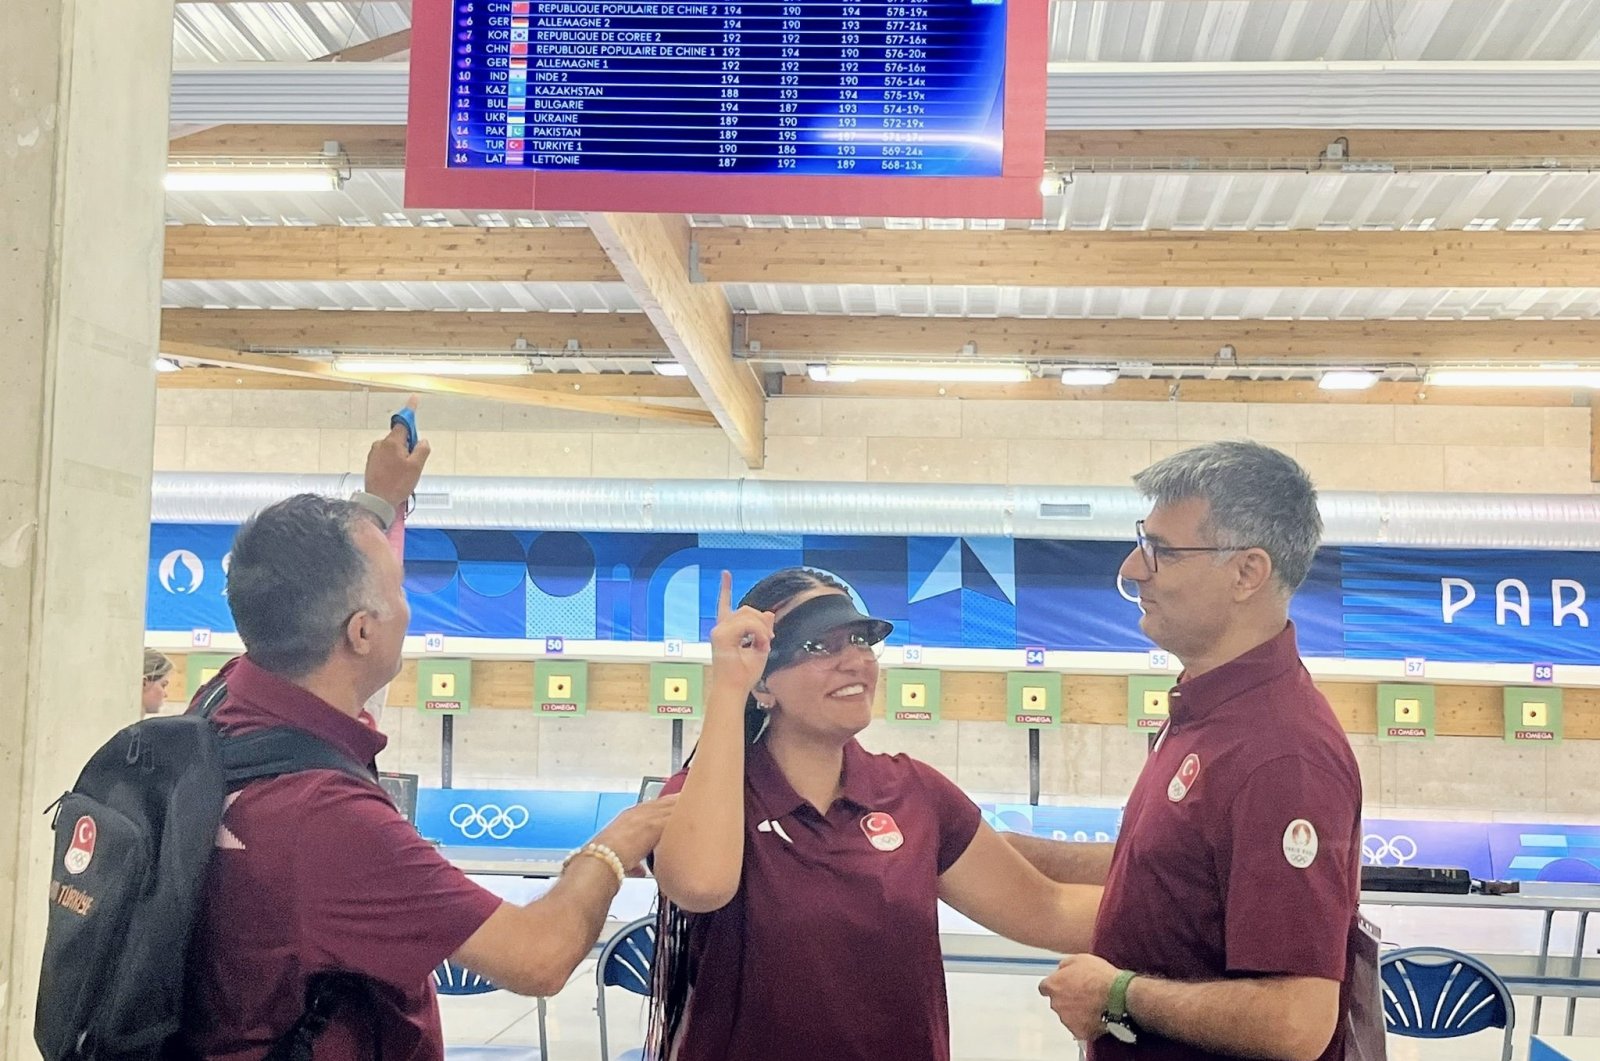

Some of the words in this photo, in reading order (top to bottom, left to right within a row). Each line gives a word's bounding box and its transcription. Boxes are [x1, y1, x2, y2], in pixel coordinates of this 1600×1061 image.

[468, 4, 473, 12] 5
[488, 4, 510, 12] CHN
[538, 4, 600, 14] REPUBLIQUE
[602, 5, 659, 13] POPULAIRE
[661, 5, 674, 14] DE
[676, 5, 708, 14] CHINE
[711, 5, 717, 14] 2
[724, 7, 742, 16] 194
[783, 7, 800, 16] 190
[842, 7, 860, 16] 194
[887, 8, 928, 17] 578-19x
[467, 17, 472, 25] 6
[488, 17, 509, 26] GER
[538, 18, 602, 27] ALLEMAGNE
[603, 19, 610, 27] 2
[724, 20, 741, 30] 194
[782, 21, 800, 30] 190
[842, 21, 860, 30] 193
[887, 22, 927, 30] 577-21x
[488, 31, 508, 39] KOR
[537, 32, 599, 41] REPUBLIQUE
[602, 32, 615, 41] DE
[617, 33, 652, 42] COREE
[654, 33, 661, 42] 2
[723, 34, 740, 43] 192
[782, 34, 800, 43] 192
[841, 35, 859, 44] 193
[886, 35, 927, 44] 577-16x
[466, 44, 471, 53] 8
[486, 44, 508, 53] CHN
[537, 46, 599, 55] REPUBLIQUE
[601, 46, 658, 55] POPULAIRE
[660, 47, 672, 56] DE
[675, 47, 708, 56] CHINE
[710, 47, 715, 56] 1
[723, 48, 740, 57] 192
[782, 48, 799, 57] 194
[841, 48, 859, 57] 190
[886, 49, 926, 58] 576-20x
[465, 58, 471, 66] 9
[487, 58, 508, 67] GER
[536, 59, 600, 68] ALLEMAGNE
[602, 60, 608, 68] 1
[722, 62, 739, 70] 192
[781, 62, 798, 71] 192
[840, 62, 858, 71] 192
[885, 62, 926, 72] 576-16x
[459, 72, 470, 80] 10
[490, 72, 507, 80] IND
[536, 73, 559, 81] INDE
[561, 73, 567, 82] 2
[722, 76, 739, 84] 194
[780, 76, 798, 85] 192
[840, 76, 858, 85] 190
[885, 76, 925, 86] 576-14x
[458, 86, 470, 94] 11
[486, 85, 507, 94] KAZ
[535, 86, 603, 95] KAZAKHSTAN
[721, 90, 738, 98] 188
[780, 90, 798, 99] 193
[839, 90, 857, 99] 194
[884, 90, 925, 100] 575-19x
[458, 99, 469, 107] 12
[487, 99, 506, 108] BUL
[534, 100, 583, 109] BULGARIE
[721, 103, 738, 112] 194
[780, 104, 797, 112] 187
[839, 104, 857, 113] 193
[884, 104, 924, 113] 574-19x
[457, 113, 469, 121] 13
[486, 113, 505, 121] UKR
[534, 114, 578, 123] UKRAINE
[720, 117, 737, 126] 189
[779, 117, 796, 126] 190
[838, 118, 856, 127] 193
[883, 118, 924, 127] 572-19x
[456, 127, 468, 135] 14
[486, 127, 504, 135] PAK
[534, 128, 580, 137] PAKISTAN
[720, 131, 737, 140] 189
[778, 131, 796, 140] 195
[456, 140, 467, 149] 15
[486, 140, 504, 149] TUR
[533, 141, 574, 150] TURKIYE
[576, 142, 582, 150] 1
[719, 145, 736, 154] 190
[778, 145, 796, 154] 186
[838, 145, 855, 154] 193
[882, 146, 922, 155] 569-24x
[455, 154, 467, 162] 16
[486, 154, 503, 163] LAT
[533, 155, 579, 164] LETTONIE
[718, 158, 736, 168] 187
[778, 159, 795, 168] 192
[837, 159, 855, 168] 189
[882, 160, 922, 168] 568-13x
[1441, 578, 1588, 627] PAR
[194, 633, 208, 642] 47
[427, 638, 441, 647] 49
[548, 640, 562, 650] 50
[668, 643, 680, 652] 51
[906, 650, 920, 659] 53
[1028, 652, 1042, 663] 54
[1152, 655, 1166, 664] 55
[1408, 662, 1422, 671] 57
[1536, 668, 1551, 678] 58
